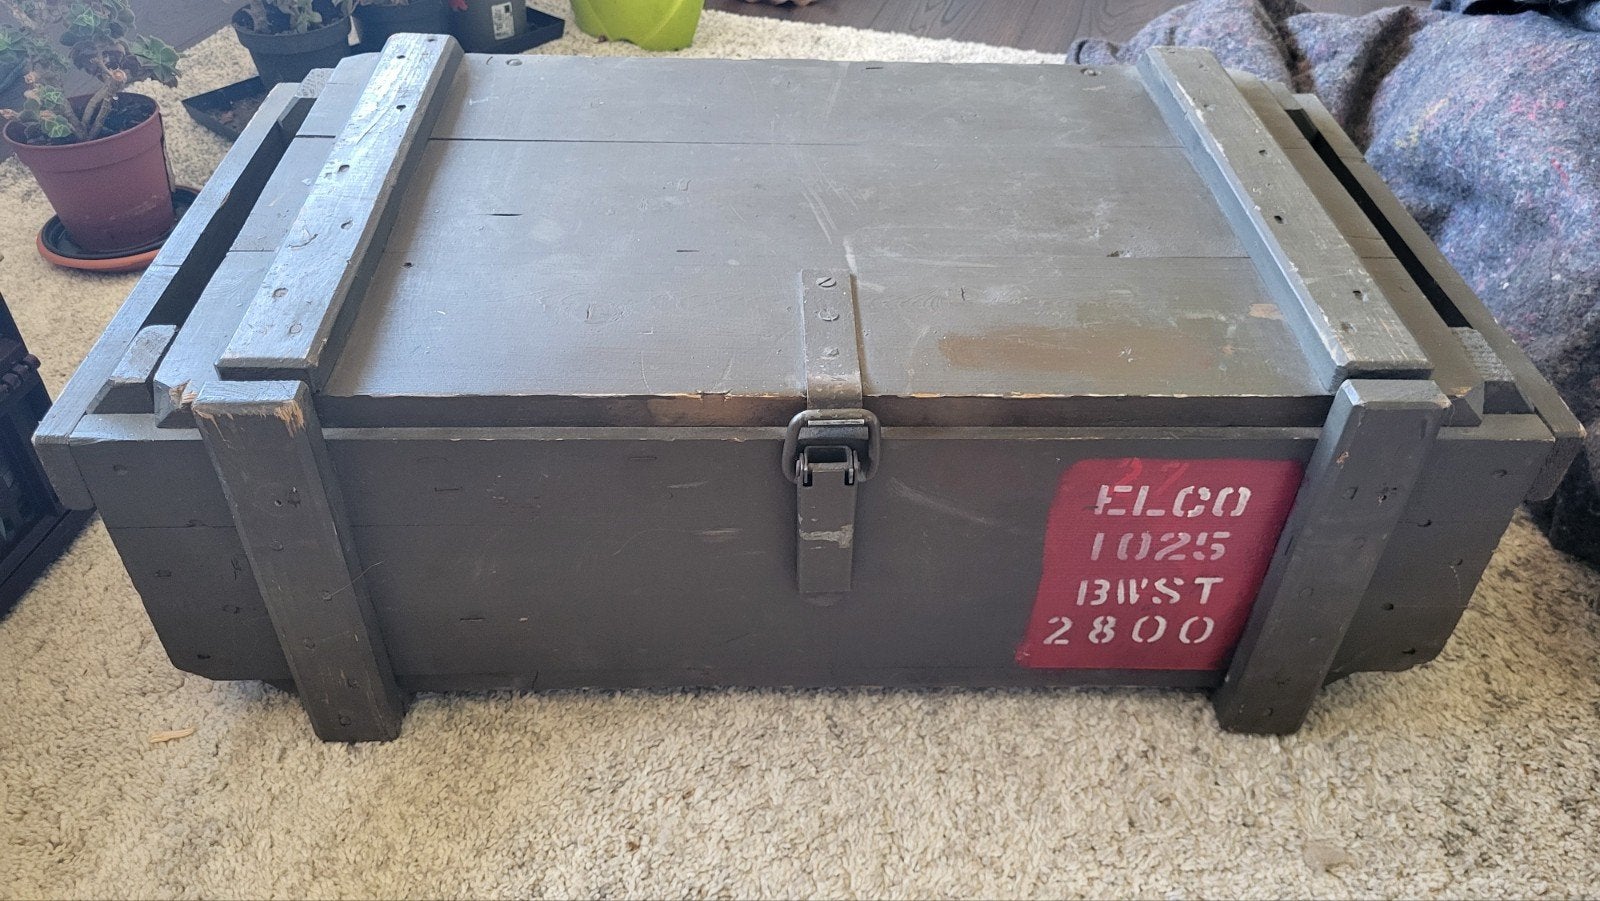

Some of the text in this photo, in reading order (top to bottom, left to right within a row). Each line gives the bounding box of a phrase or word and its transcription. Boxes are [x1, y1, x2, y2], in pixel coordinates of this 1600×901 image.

[1094, 484, 1251, 517] ELCO
[1091, 531, 1230, 561] 1025
[1076, 577, 1224, 606] BWST
[1043, 615, 1215, 644] 2800
